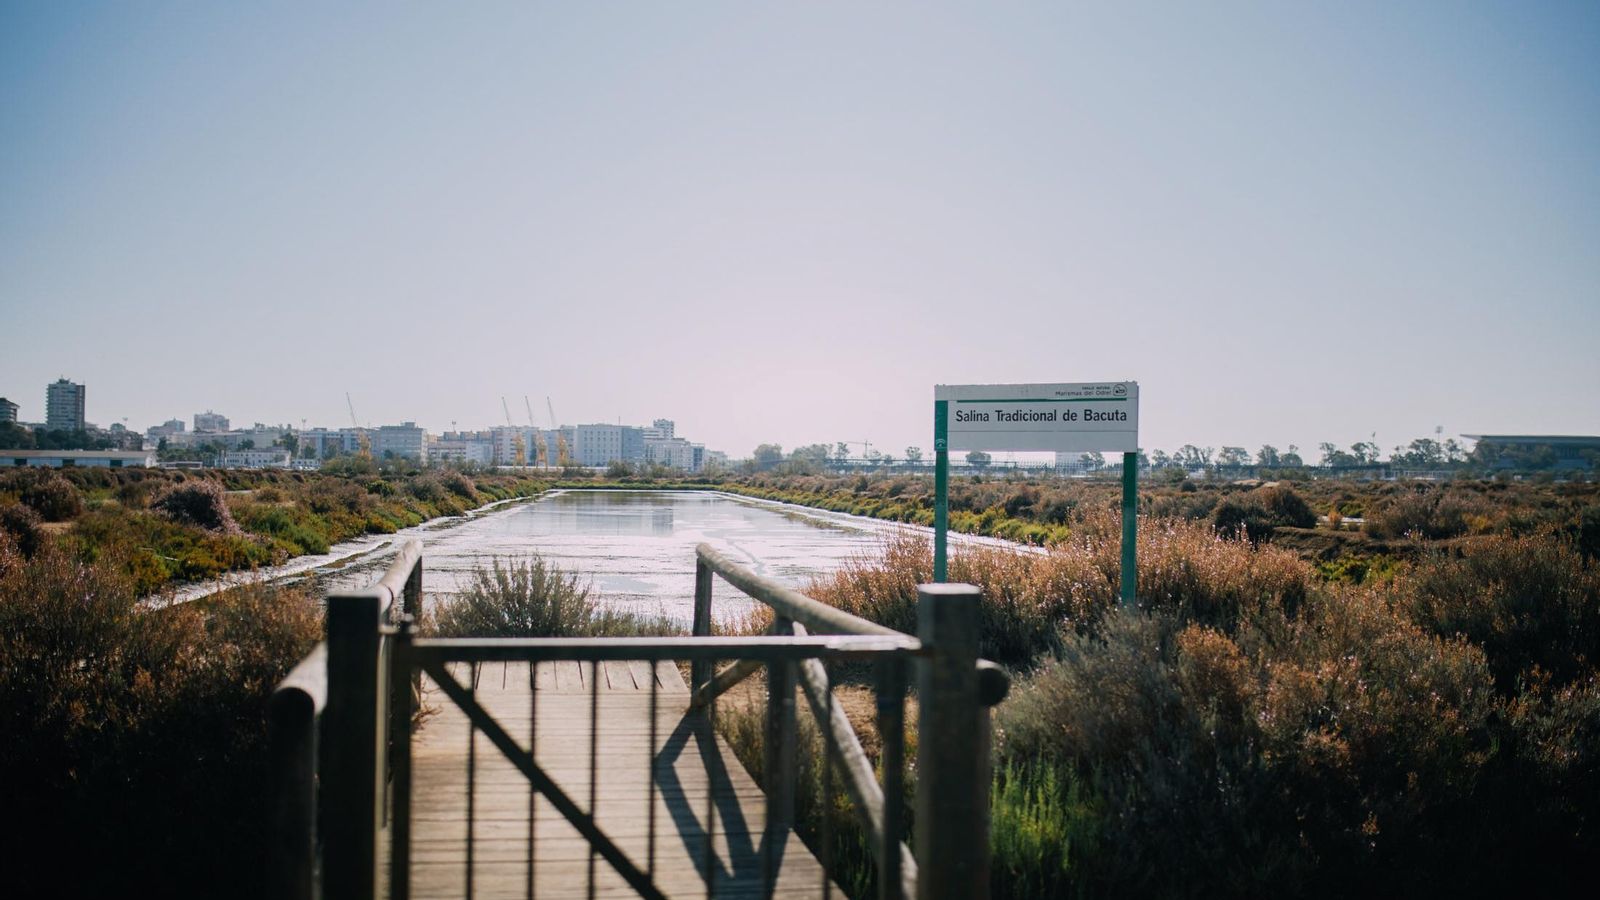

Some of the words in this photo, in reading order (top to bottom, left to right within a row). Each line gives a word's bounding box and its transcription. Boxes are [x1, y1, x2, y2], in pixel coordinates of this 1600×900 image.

[955, 410, 990, 422] Salina
[995, 409, 1057, 422] Tradicional
[1062, 409, 1078, 422] de
[1084, 409, 1127, 422] Bacuta
